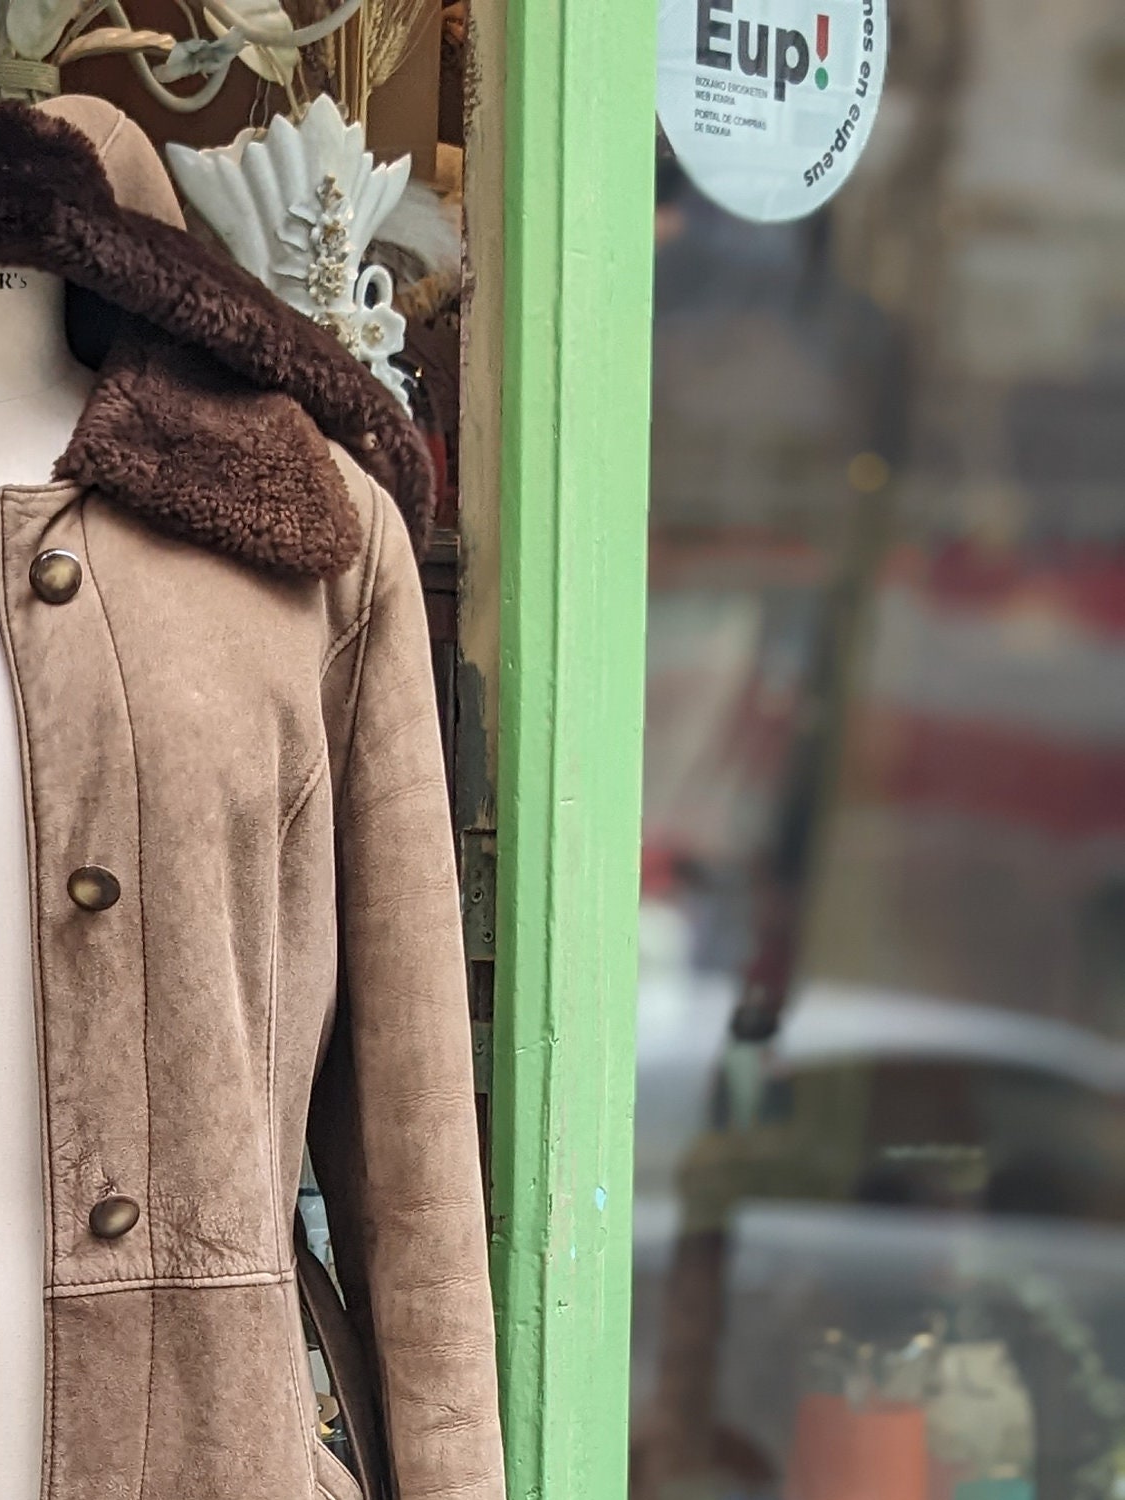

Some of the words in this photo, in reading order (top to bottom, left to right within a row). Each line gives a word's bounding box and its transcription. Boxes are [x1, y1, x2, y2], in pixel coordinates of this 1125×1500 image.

[696, 0, 829, 102] Eup!
[855, 61, 871, 98] en
[803, 104, 860, 187] eup.eus
